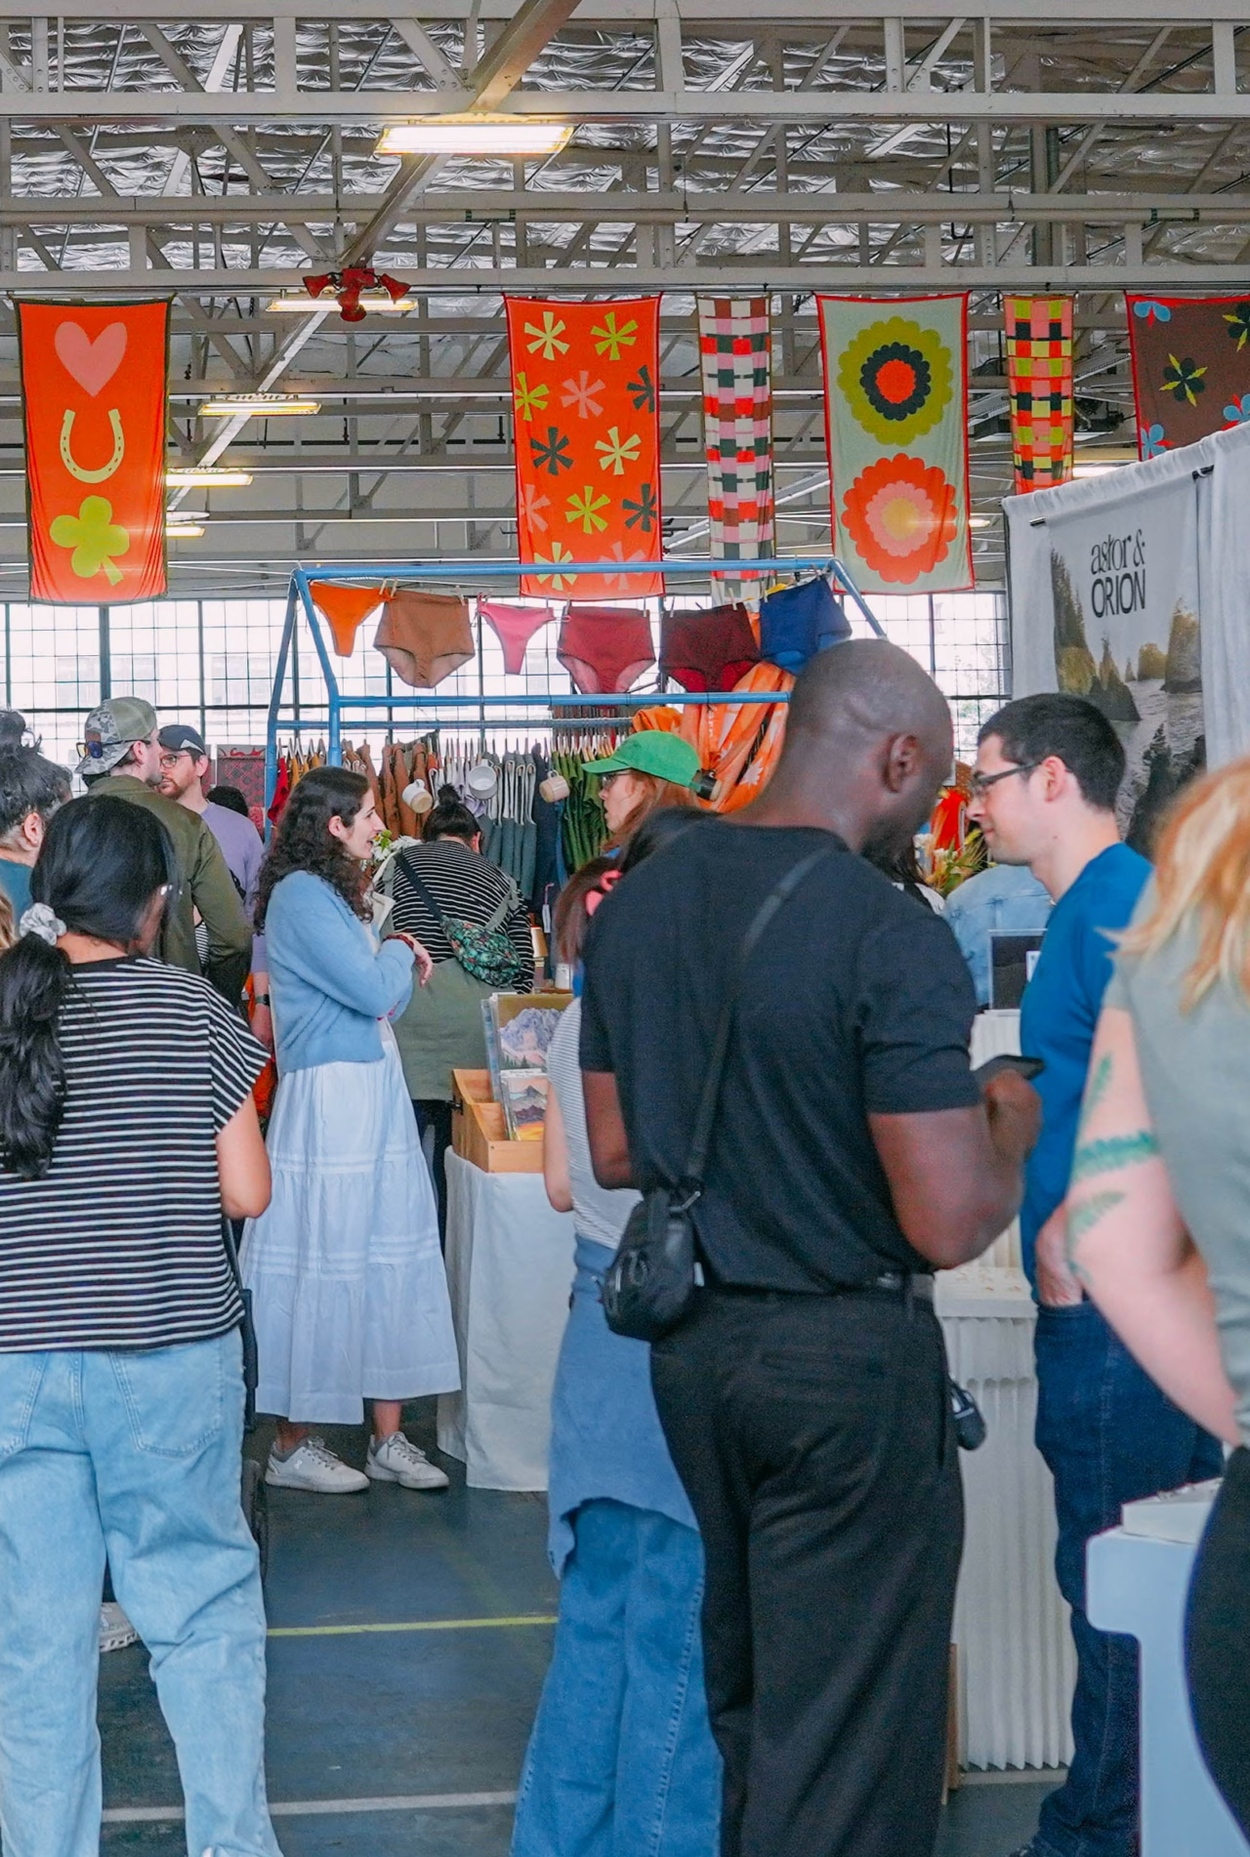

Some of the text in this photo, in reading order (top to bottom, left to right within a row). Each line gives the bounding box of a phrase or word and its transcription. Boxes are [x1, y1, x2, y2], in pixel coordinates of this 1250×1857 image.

[1091, 529, 1145, 576] astor &
[1091, 569, 1145, 619] ORION
